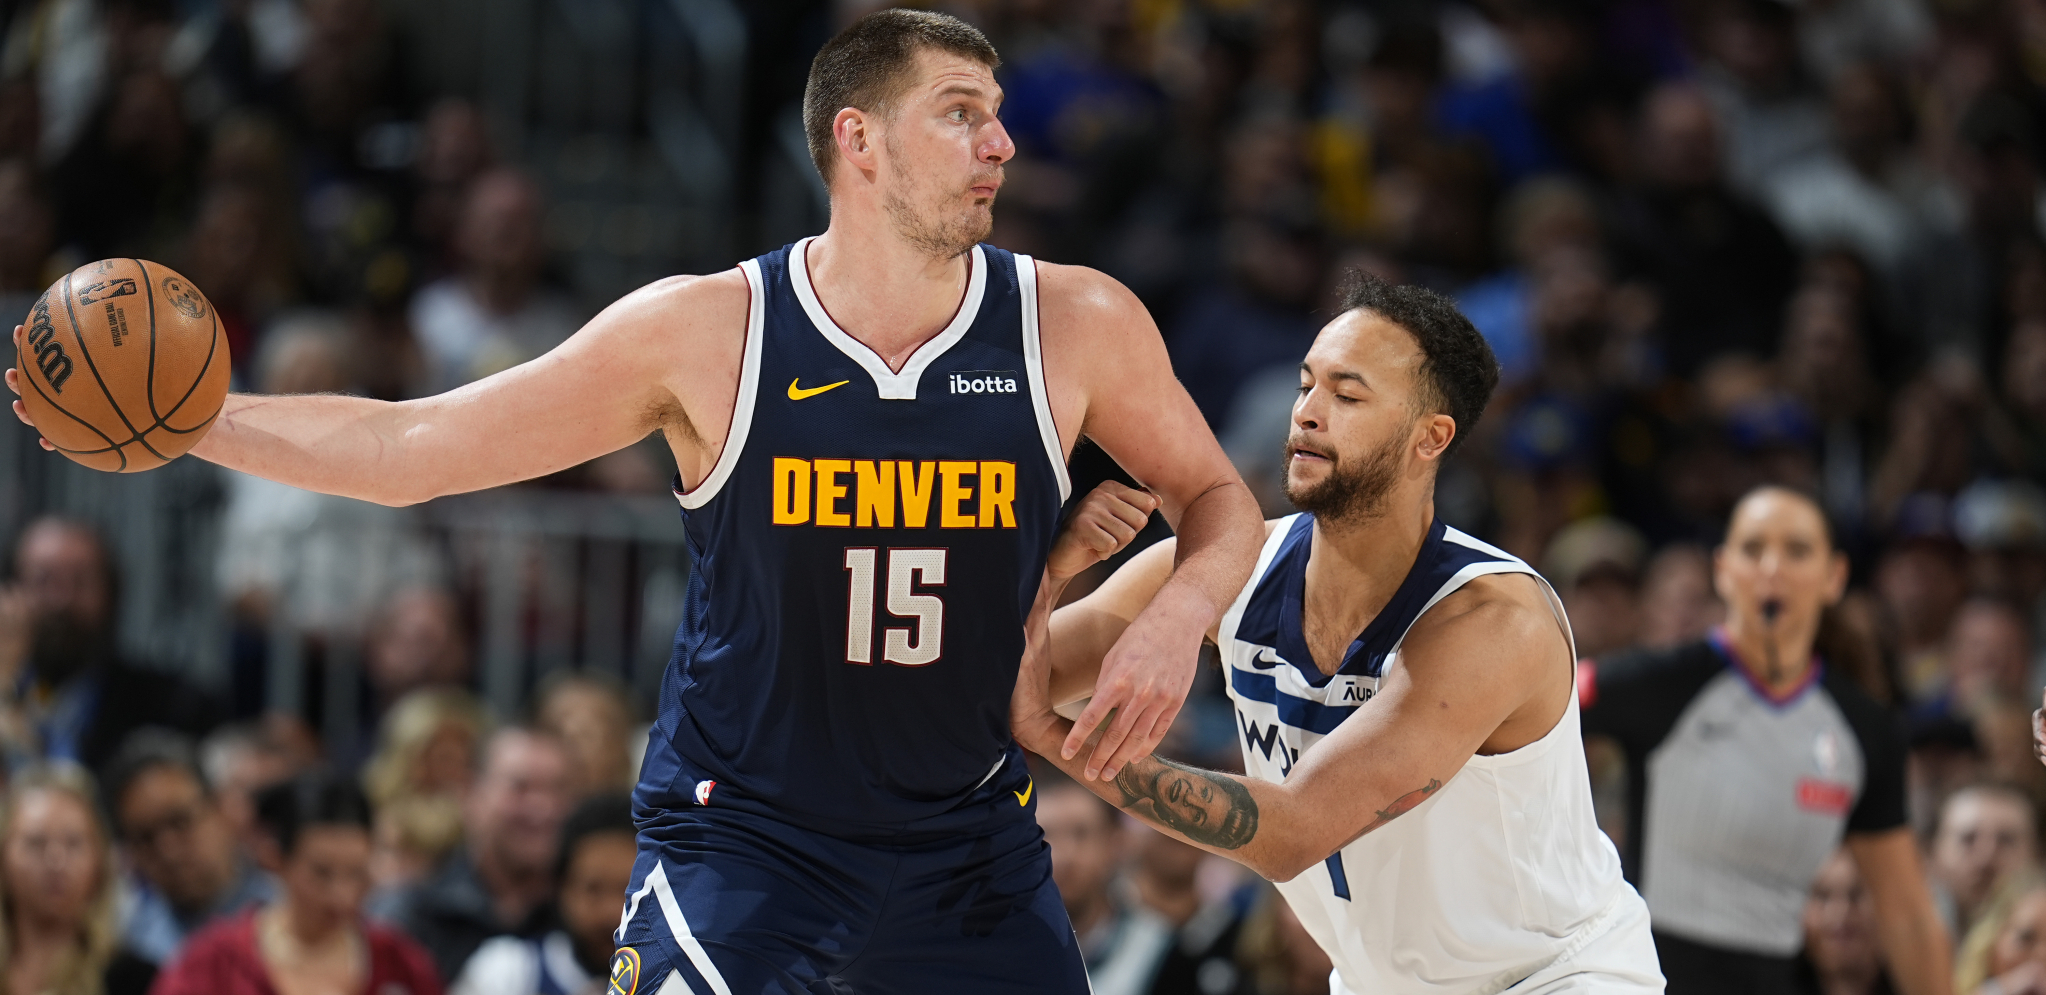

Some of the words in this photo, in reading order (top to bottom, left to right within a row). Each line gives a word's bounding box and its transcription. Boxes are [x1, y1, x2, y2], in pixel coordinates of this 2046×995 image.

[950, 374, 1017, 394] ibotta
[772, 456, 1018, 529] DENVER
[843, 546, 949, 666] 15
